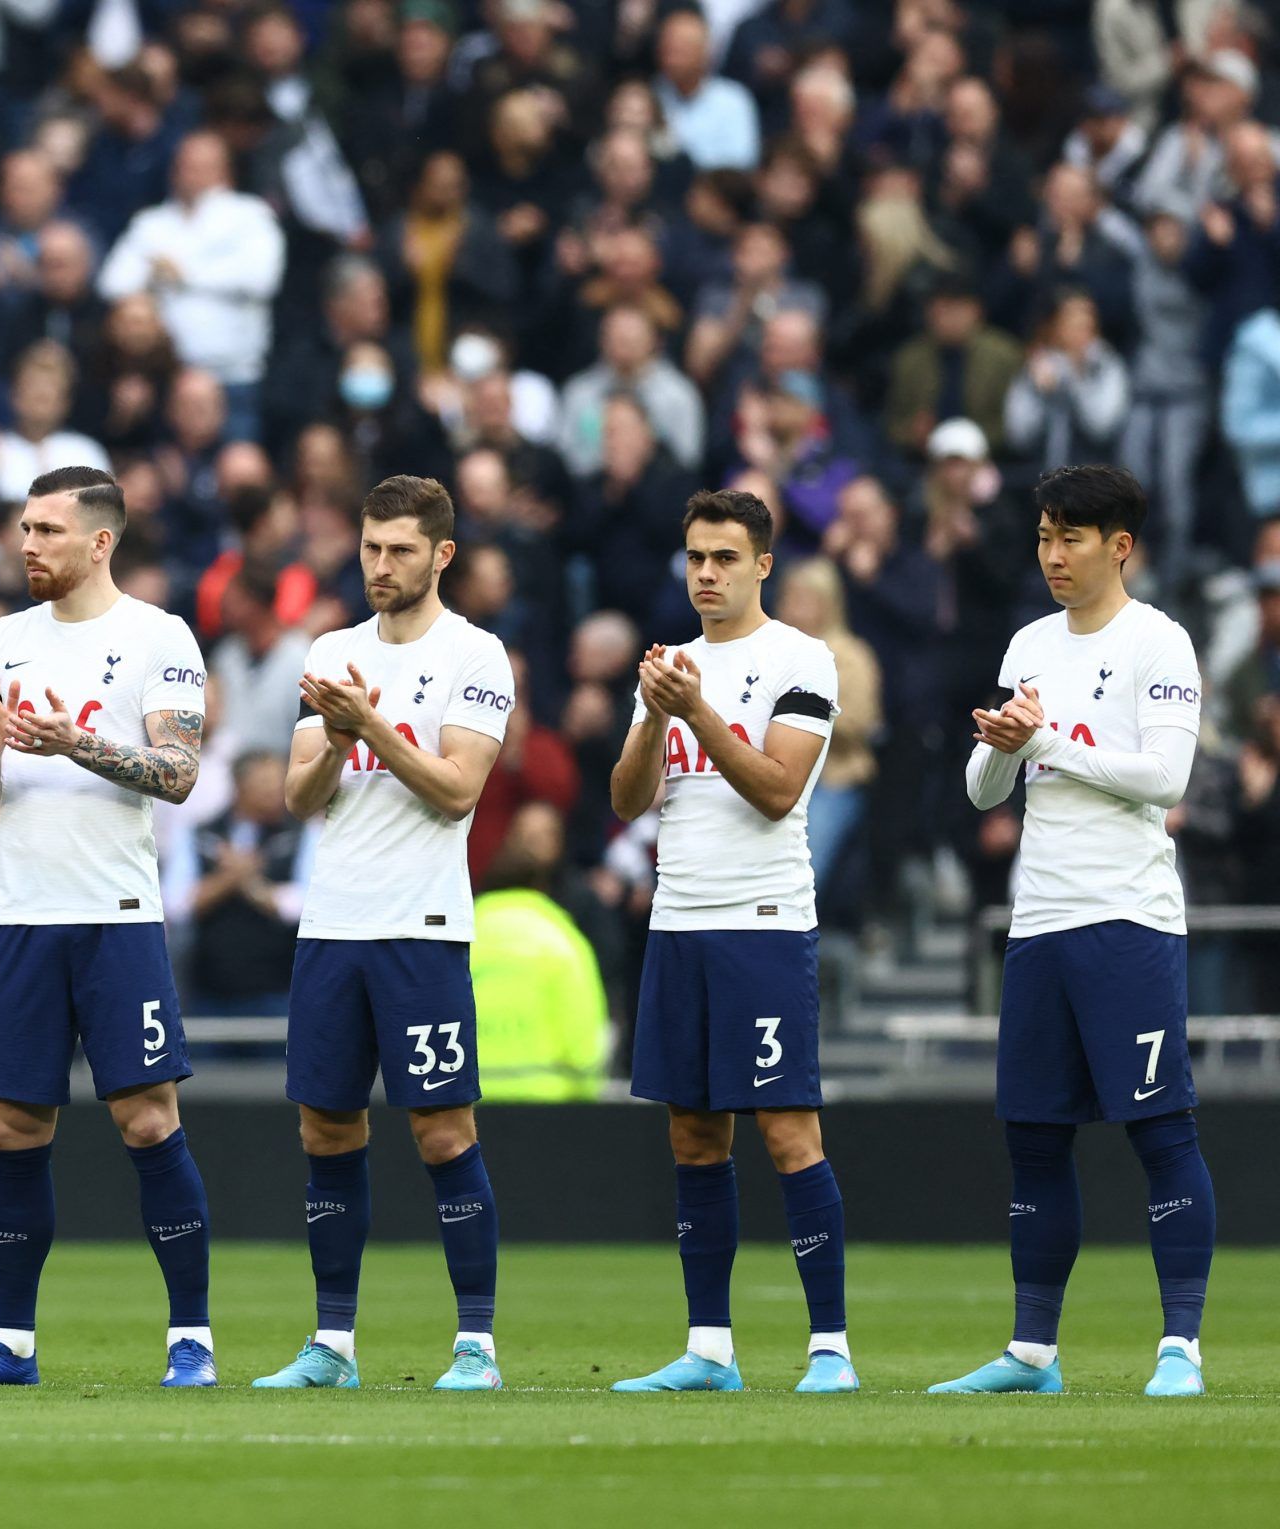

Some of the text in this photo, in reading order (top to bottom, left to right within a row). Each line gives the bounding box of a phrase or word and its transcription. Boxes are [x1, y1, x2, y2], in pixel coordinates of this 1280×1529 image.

[142, 999, 166, 1051] 5
[406, 1021, 465, 1076] 33
[755, 1017, 783, 1068] 3
[1136, 1029, 1166, 1085] 7
[305, 1201, 346, 1213] SPURS
[438, 1202, 483, 1214] SPURS
[1148, 1198, 1193, 1213] SPURS
[151, 1220, 202, 1234] SPURS
[791, 1232, 829, 1248] SPURS
